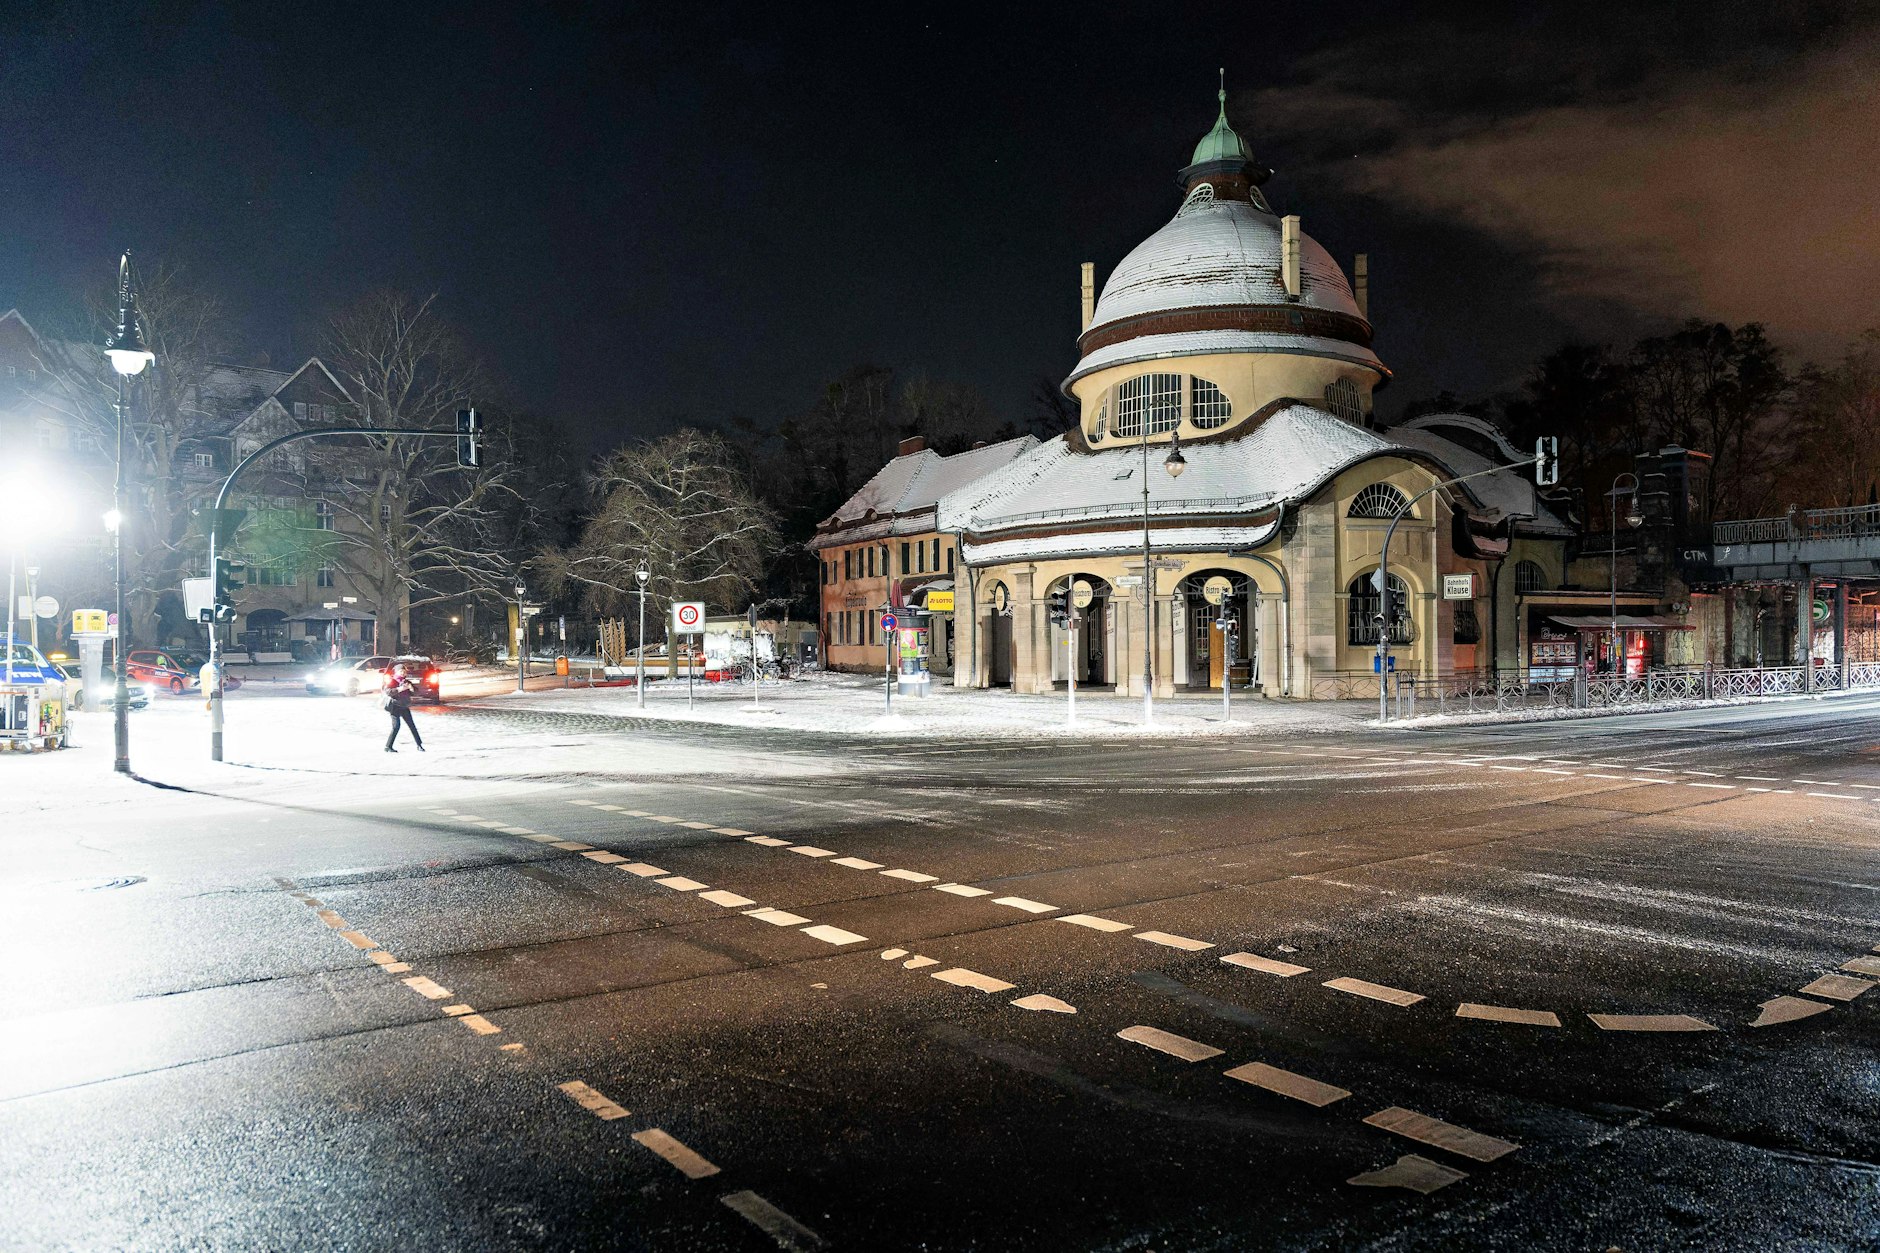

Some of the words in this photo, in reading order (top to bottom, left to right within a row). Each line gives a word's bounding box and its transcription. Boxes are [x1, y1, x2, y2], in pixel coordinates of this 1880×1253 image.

[1683, 550, 1708, 561] CTM
[1447, 586, 1469, 595] Klause
[682, 610, 695, 620] 30
